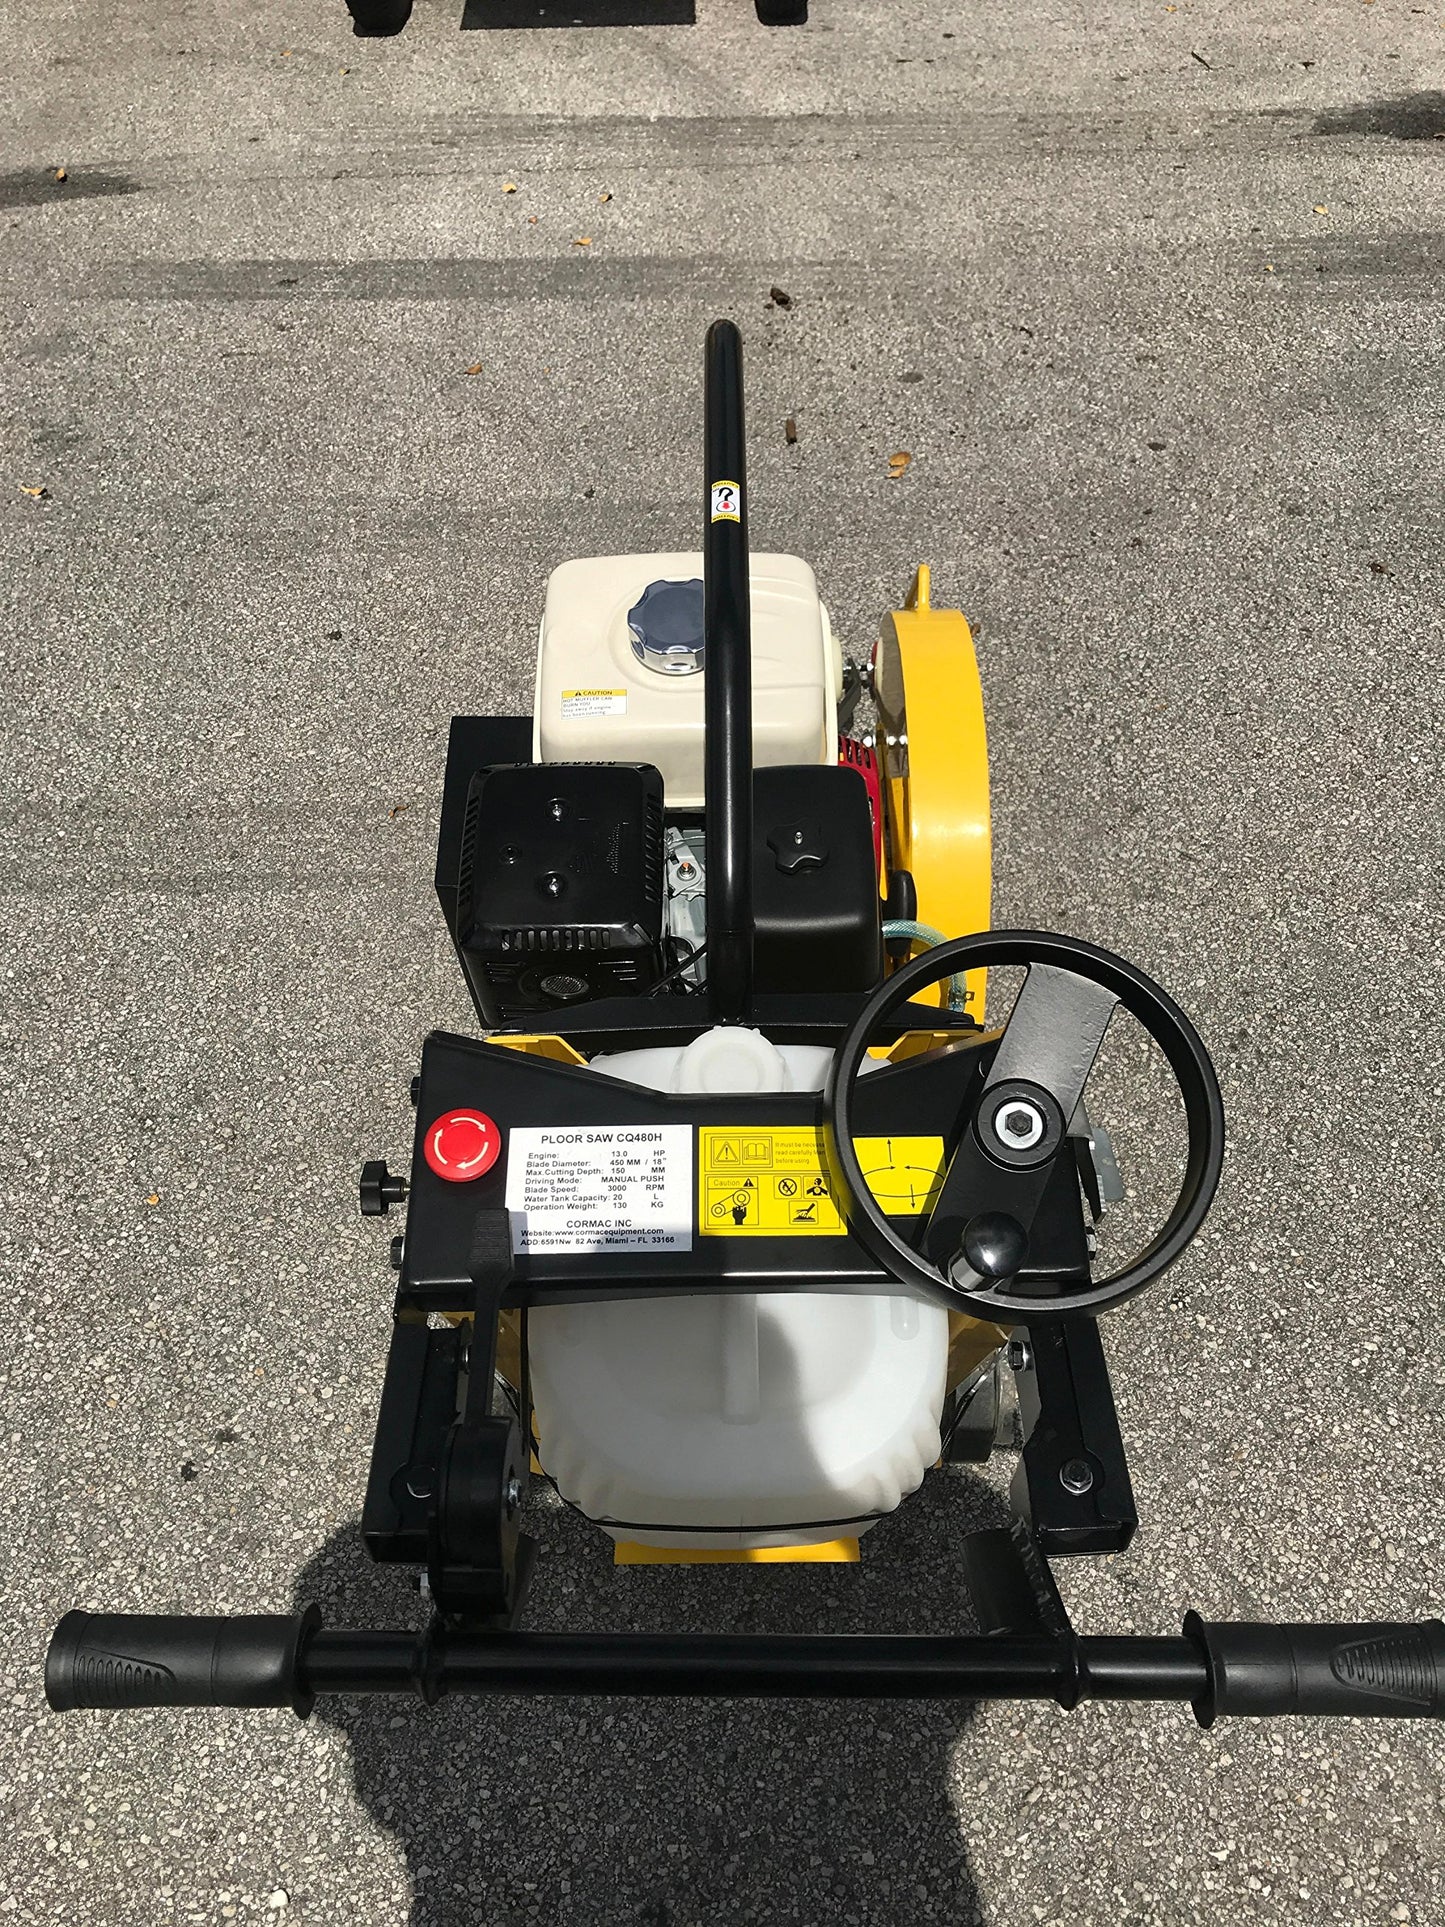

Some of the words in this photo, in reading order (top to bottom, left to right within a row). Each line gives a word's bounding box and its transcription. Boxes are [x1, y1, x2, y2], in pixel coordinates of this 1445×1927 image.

[541, 1135, 583, 1144] PLOOR
[586, 1134, 613, 1143] SAW
[616, 1133, 662, 1143] CQ480H
[528, 1152, 559, 1160] Engine:
[788, 1149, 811, 1157] carefully
[577, 1168, 604, 1176] Depth:
[525, 1177, 555, 1185] Driving
[714, 1178, 740, 1187] Caution
[551, 1186, 579, 1194] Speed:
[572, 1194, 610, 1202] Capacity:
[567, 1203, 598, 1211] Weight:
[566, 1220, 612, 1228] CORMAC
[614, 1219, 632, 1227] INC
[521, 1227, 664, 1236] Website:www.cormacequipment.com
[587, 1237, 603, 1245] Ave,
